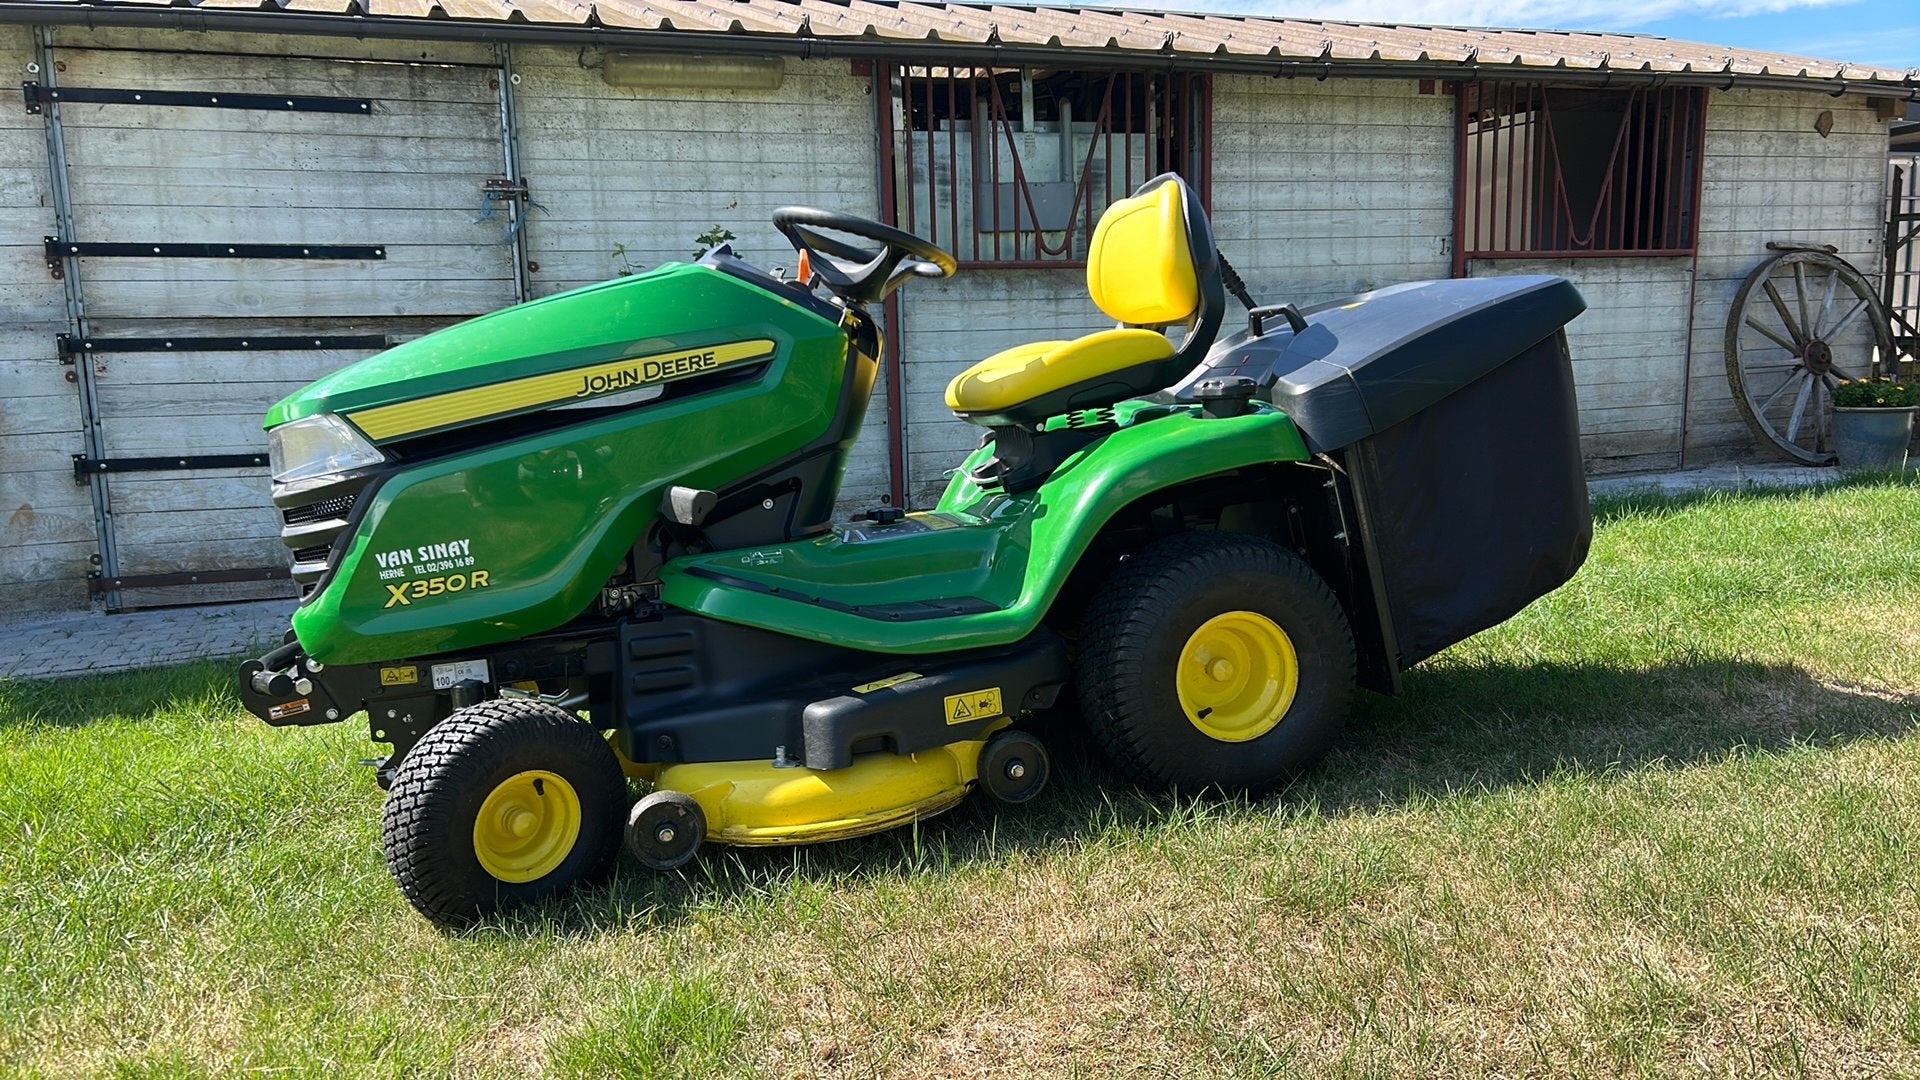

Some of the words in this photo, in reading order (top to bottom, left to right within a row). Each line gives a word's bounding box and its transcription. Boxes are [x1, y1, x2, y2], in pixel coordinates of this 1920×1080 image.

[577, 367, 638, 395] JOHN
[643, 352, 716, 379] DEERE
[375, 548, 414, 568] VAN
[417, 538, 470, 562] SINAY
[379, 568, 405, 580] HERNE
[413, 564, 427, 575] TEL
[426, 560, 454, 573] 02/396
[455, 558, 465, 568] 16
[436, 676, 450, 686] 100
